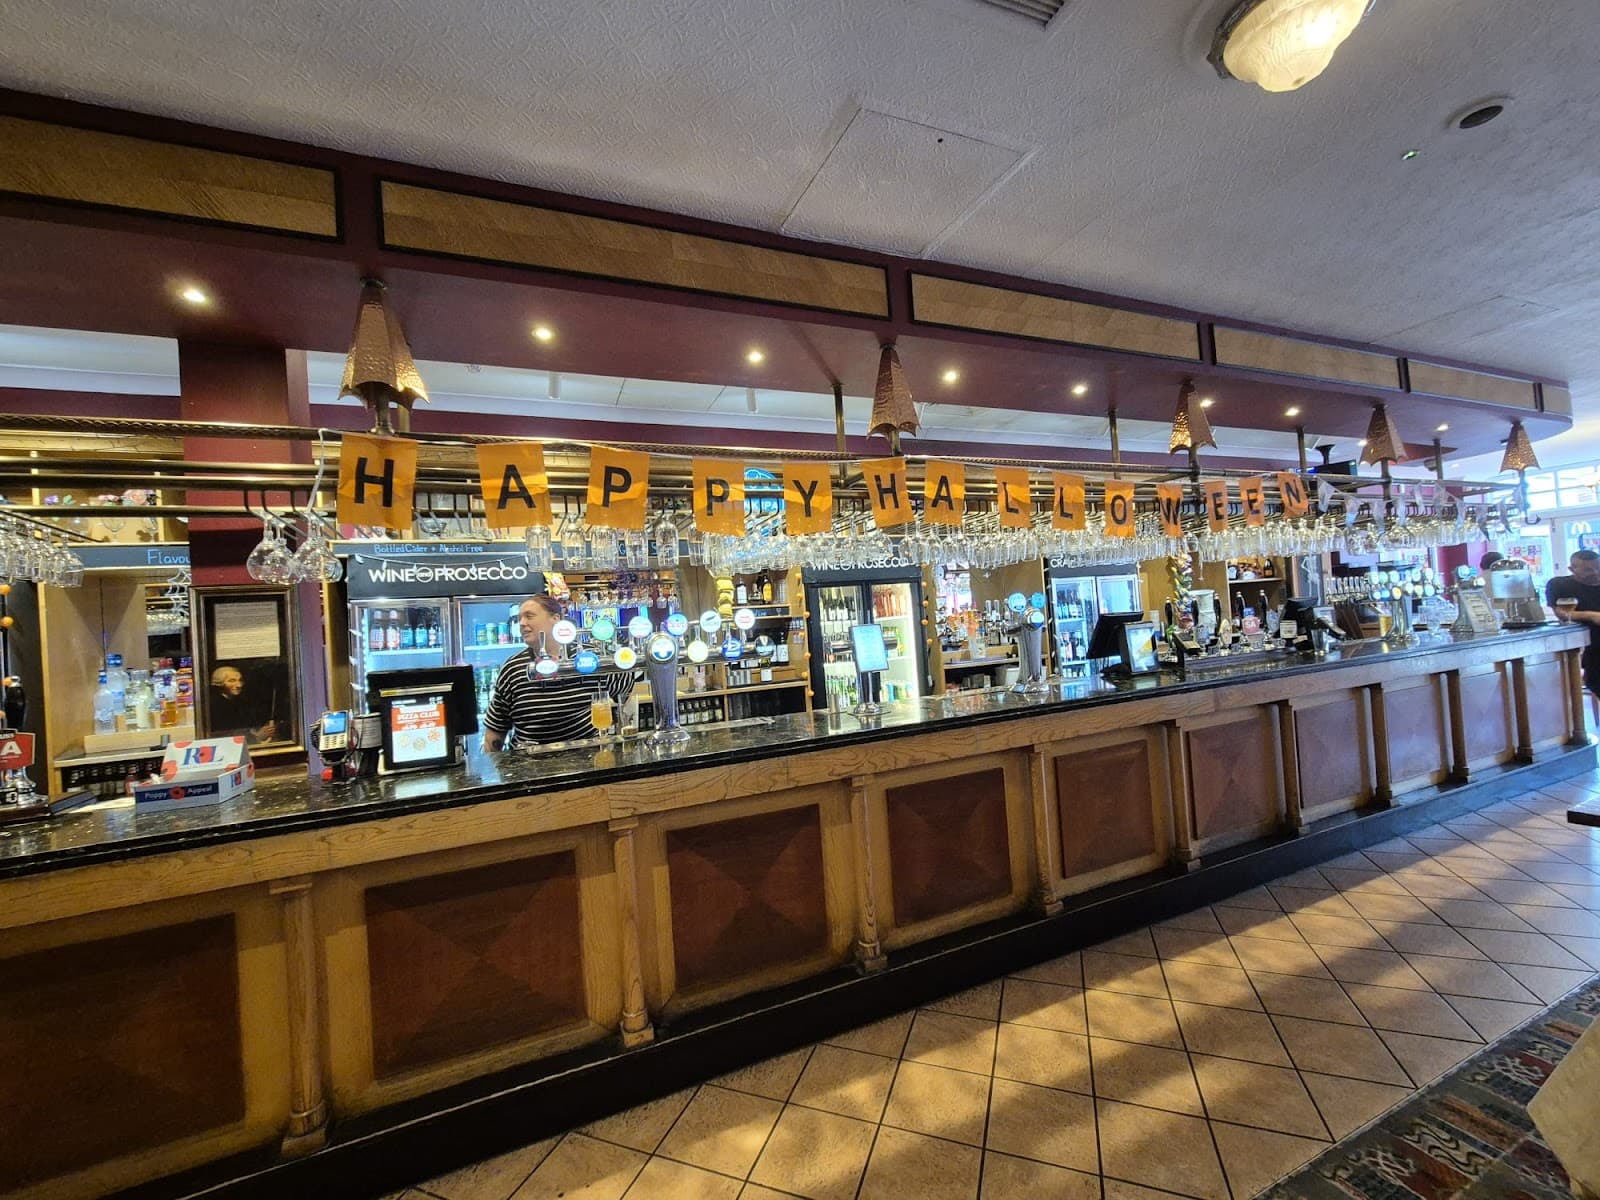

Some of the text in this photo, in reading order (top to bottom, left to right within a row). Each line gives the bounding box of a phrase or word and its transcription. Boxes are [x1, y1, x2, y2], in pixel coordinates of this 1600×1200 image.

[368, 567, 415, 583] WINE
[435, 566, 528, 582] PROSECCO
[0, 741, 23, 755] A
[144, 785, 212, 800] Poppy Appeal
